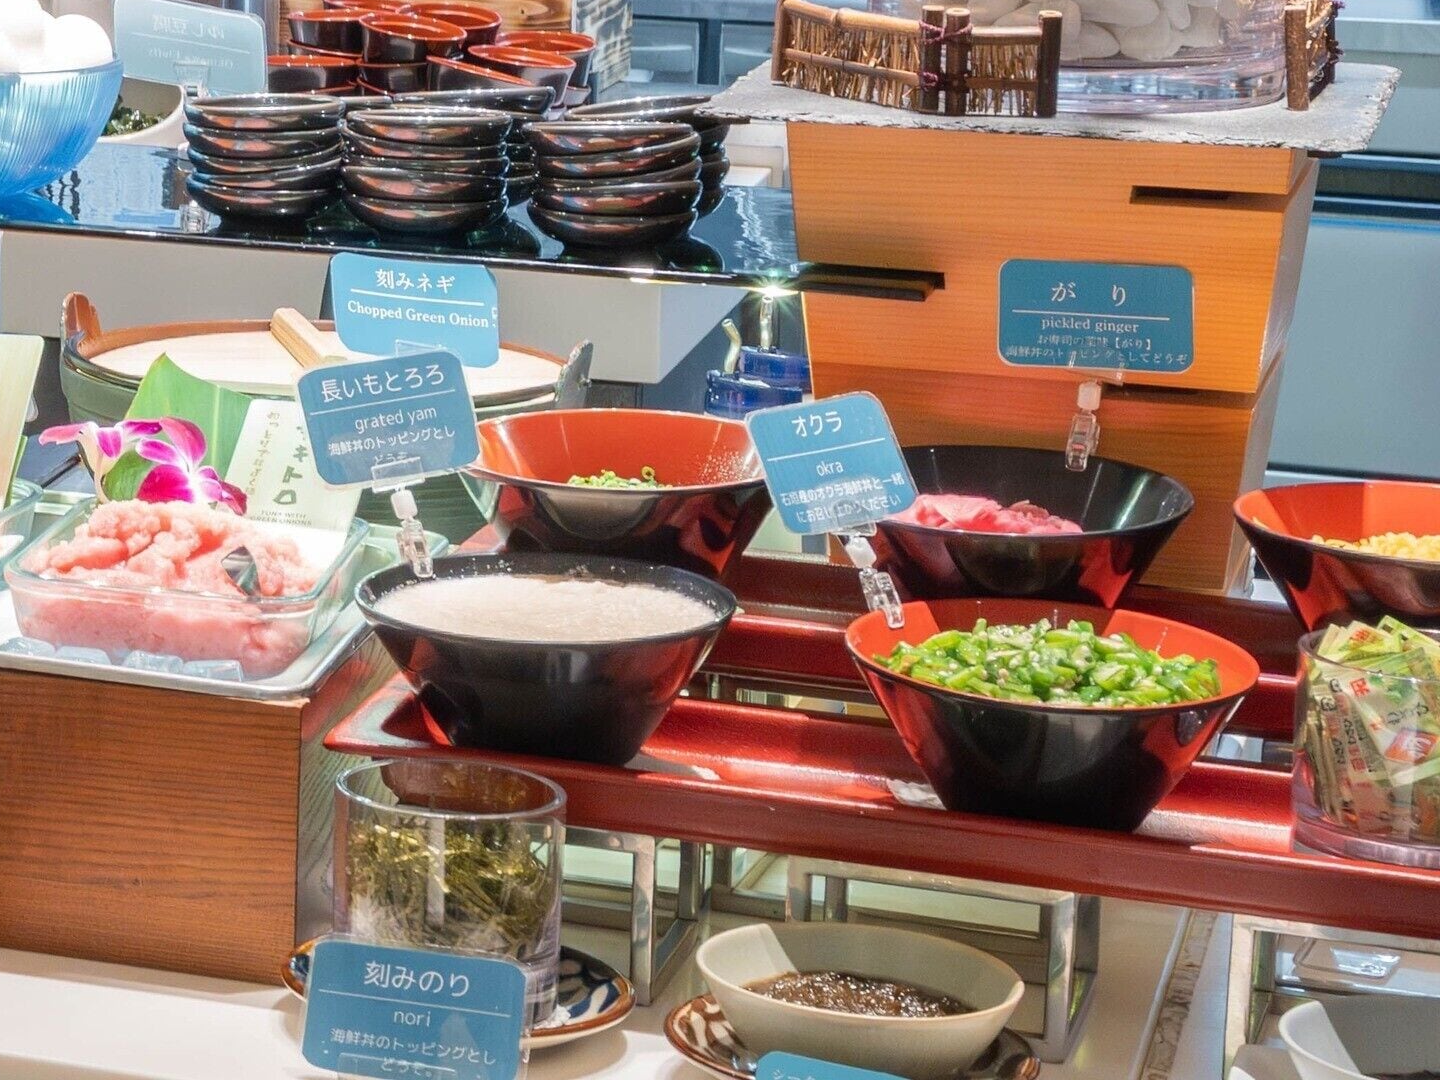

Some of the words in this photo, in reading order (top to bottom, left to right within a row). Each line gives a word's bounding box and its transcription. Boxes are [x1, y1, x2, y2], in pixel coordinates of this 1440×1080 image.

[375, 268, 455, 294] 刻みネギ
[347, 300, 402, 320] Chopped
[405, 308, 446, 324] Green
[449, 311, 489, 328] Onion
[1041, 318, 1091, 330] pickled
[1095, 321, 1139, 333] ginger
[320, 363, 445, 404] 長いもとろろ
[355, 412, 404, 434] grated
[407, 405, 438, 429] yam
[791, 410, 843, 438] オクラ
[272, 426, 308, 505] ギトロ
[816, 461, 844, 477] okra
[364, 960, 470, 997] 刻みのり
[394, 1010, 431, 1027] nori
[330, 1027, 496, 1066] 海鮮丼のトッピングとし
